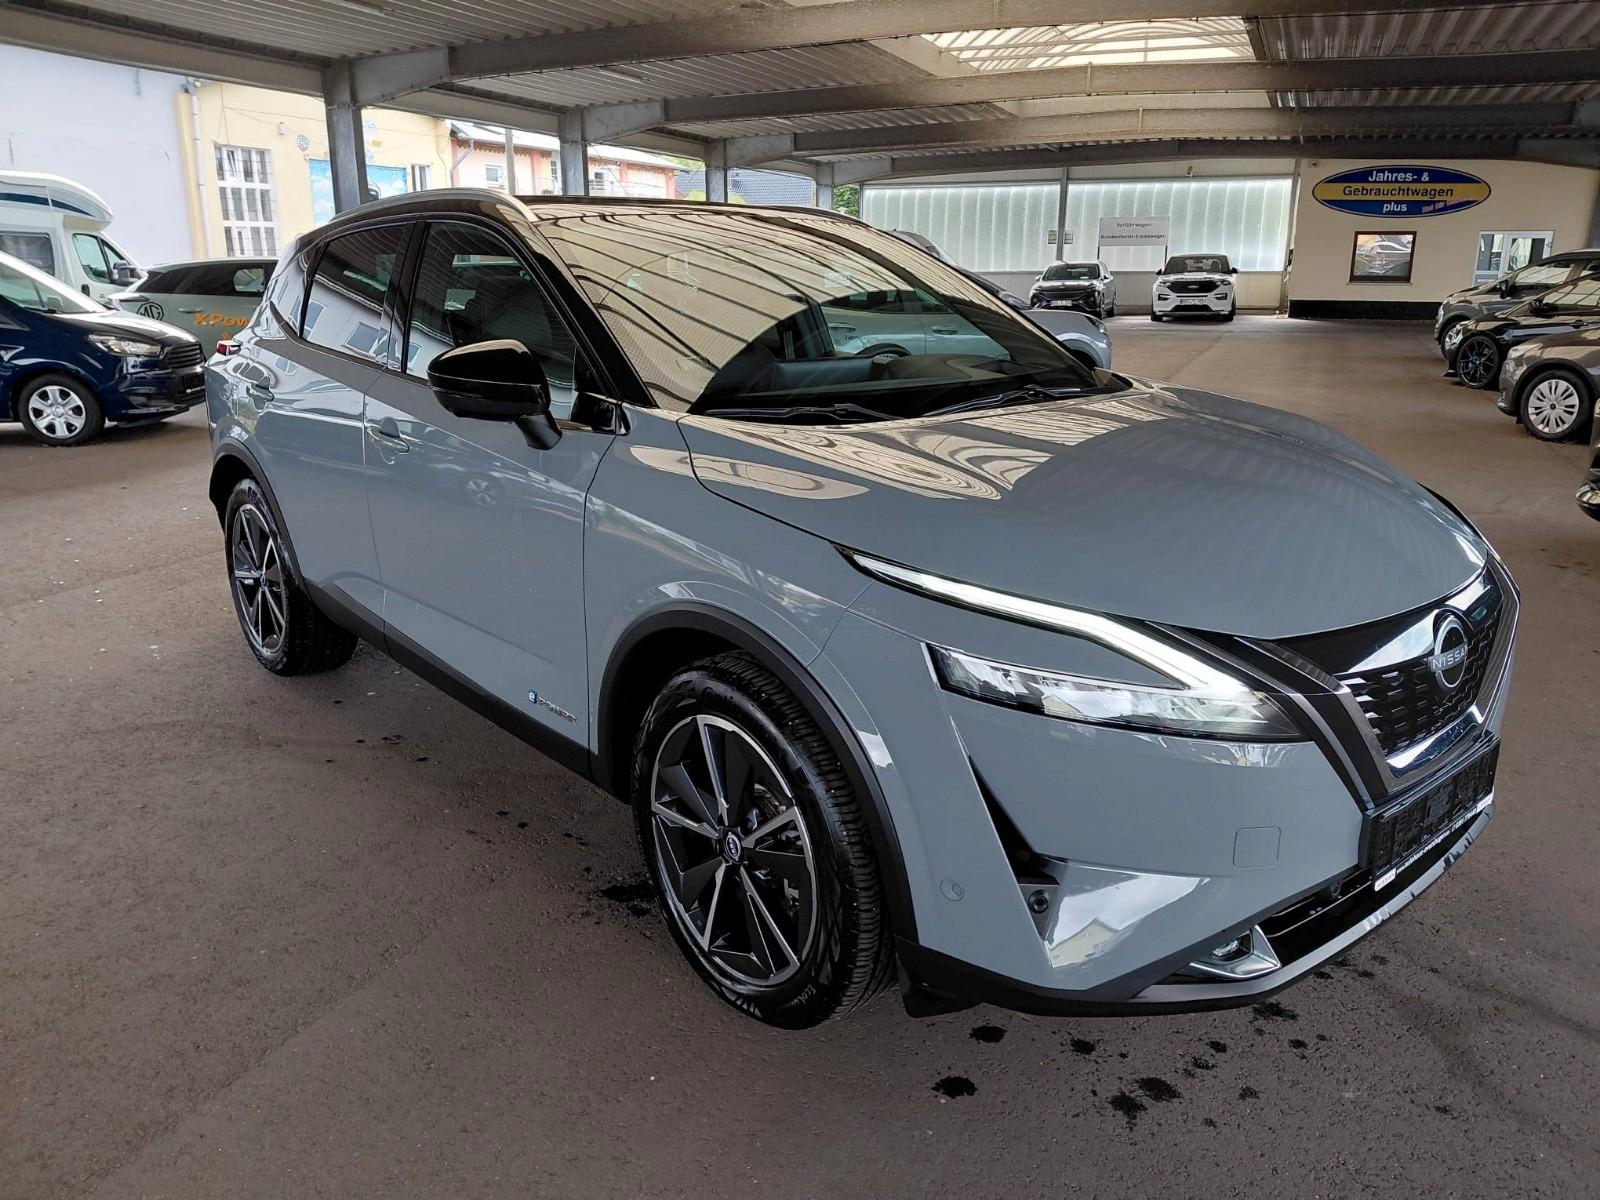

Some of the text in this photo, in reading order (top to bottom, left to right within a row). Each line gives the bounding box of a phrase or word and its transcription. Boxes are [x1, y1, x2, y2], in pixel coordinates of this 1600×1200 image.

[1368, 170, 1430, 182] Jahres- &
[1343, 185, 1454, 199] Gebrauchtwagen
[1382, 202, 1408, 213] plus
